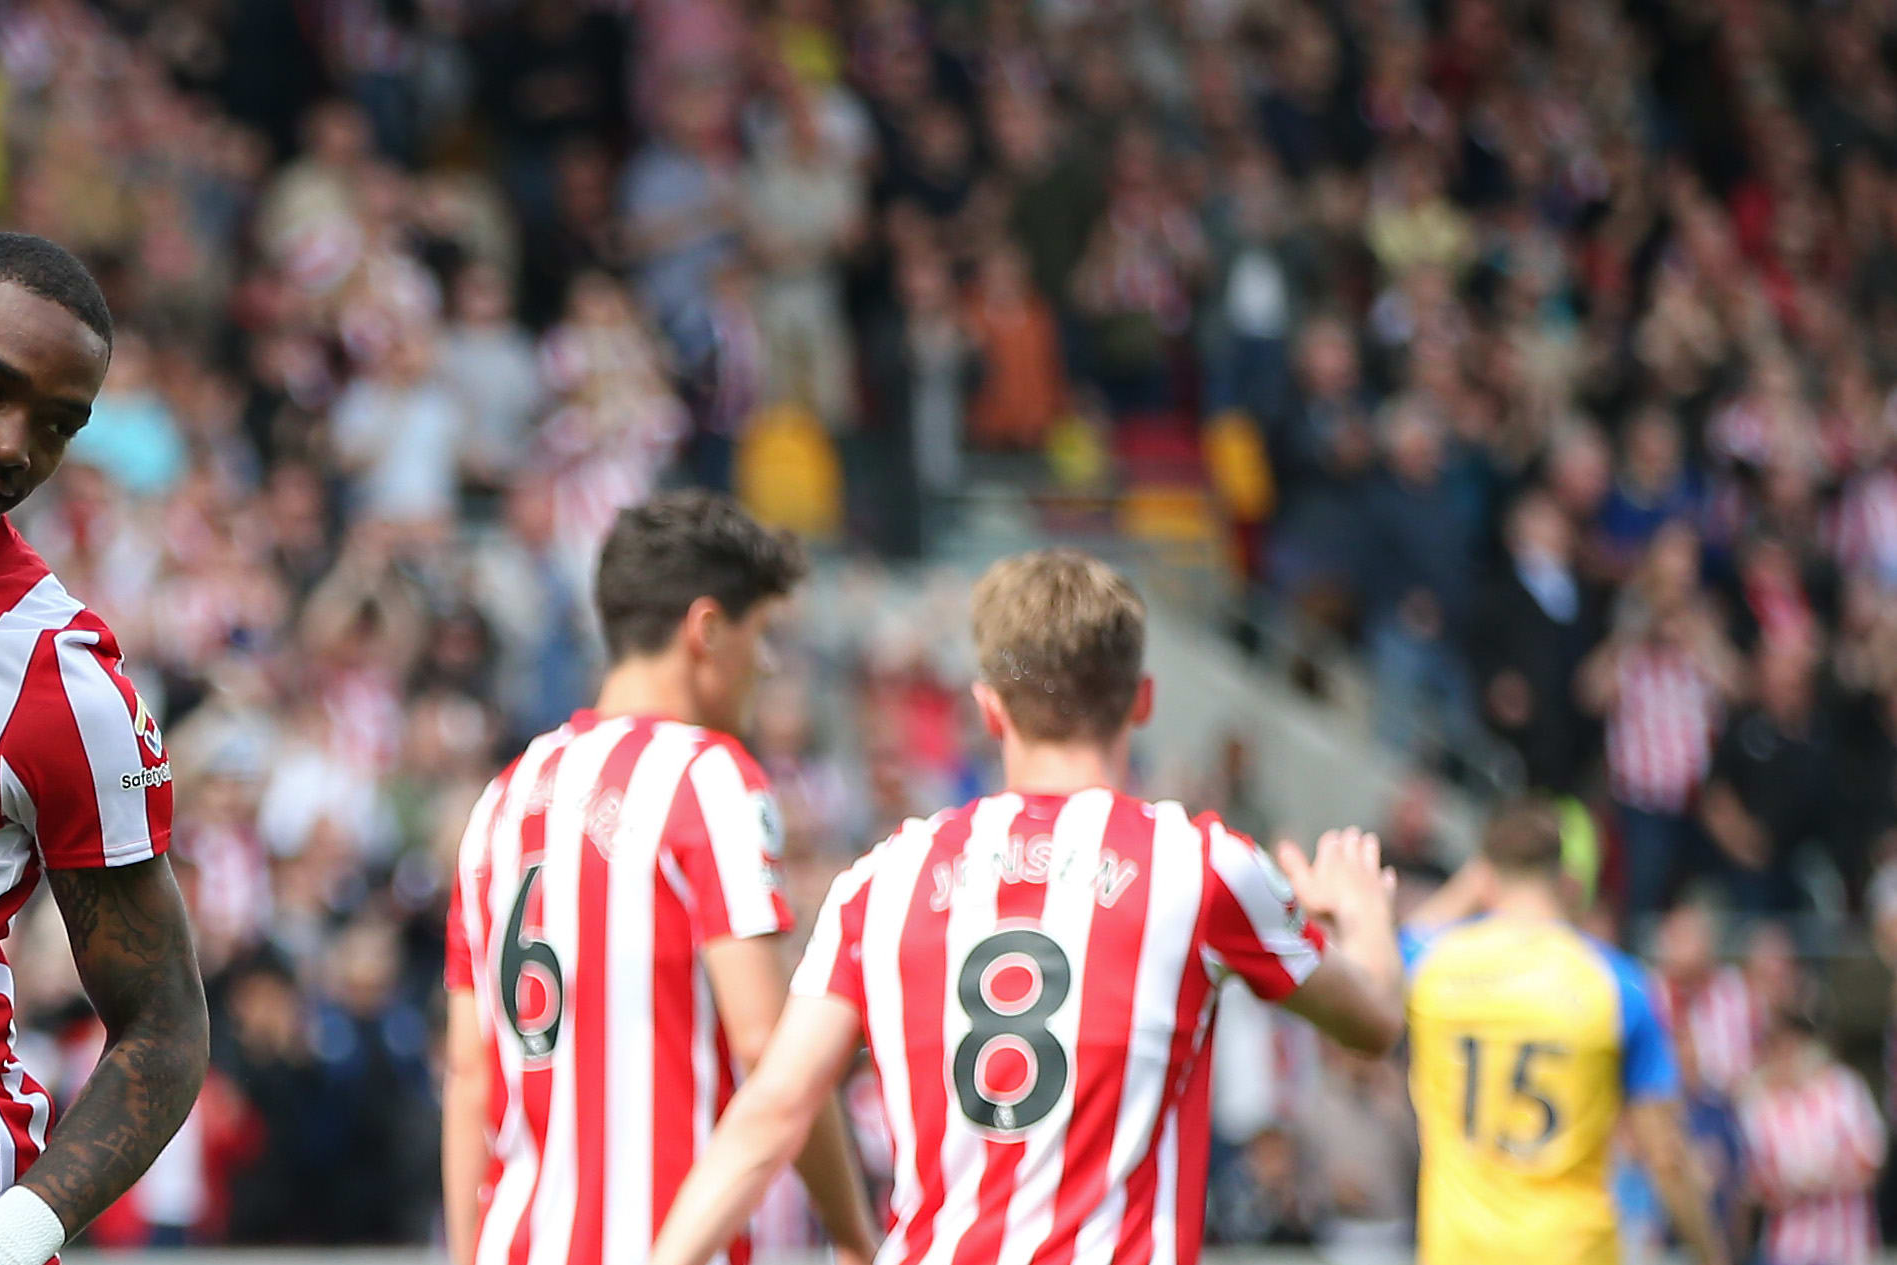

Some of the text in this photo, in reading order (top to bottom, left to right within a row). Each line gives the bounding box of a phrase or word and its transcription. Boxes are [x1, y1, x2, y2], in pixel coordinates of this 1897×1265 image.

[929, 833, 1140, 912] JNSN
[499, 861, 565, 1060] 6
[953, 927, 1072, 1133] 8
[1457, 1036, 1574, 1160] 15
